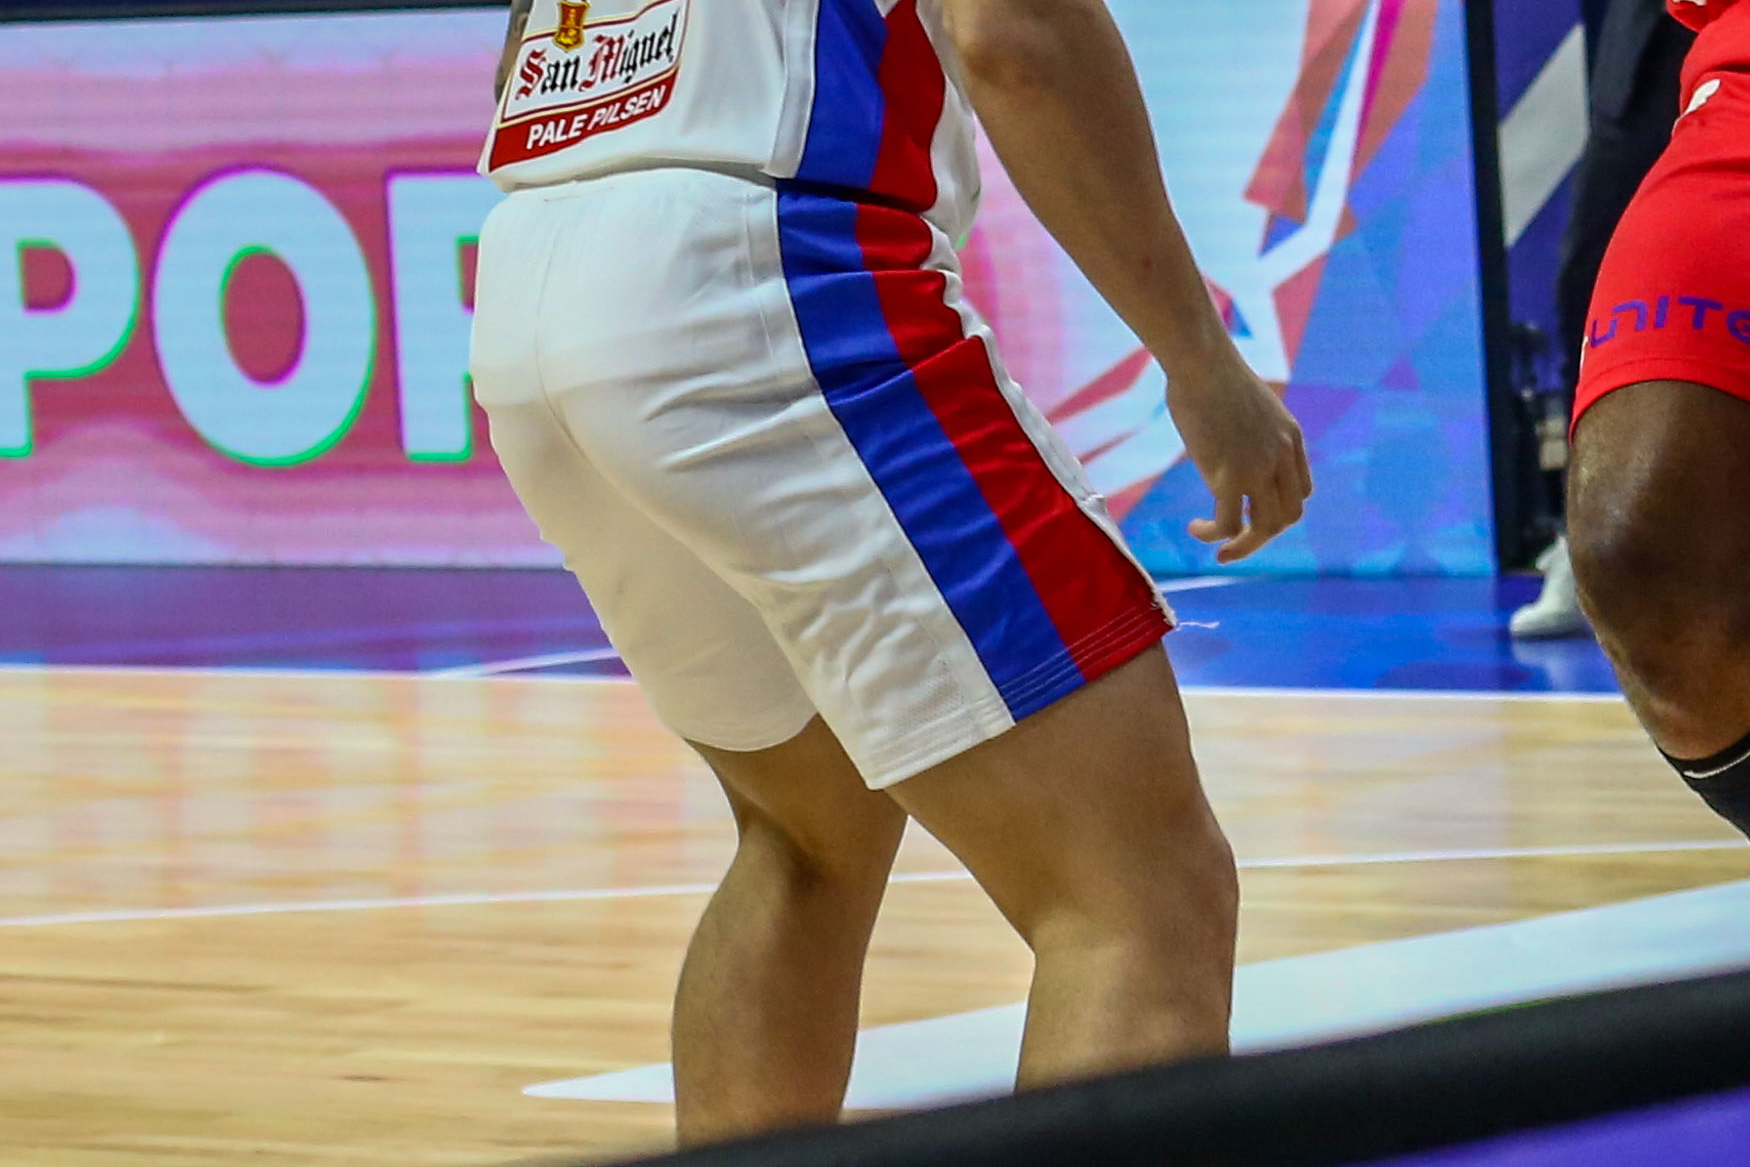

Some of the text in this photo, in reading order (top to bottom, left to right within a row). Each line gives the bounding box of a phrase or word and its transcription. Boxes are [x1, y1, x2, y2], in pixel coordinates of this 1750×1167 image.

[515, 7, 680, 100] San Miguel
[526, 84, 667, 150] PALE PILSEN
